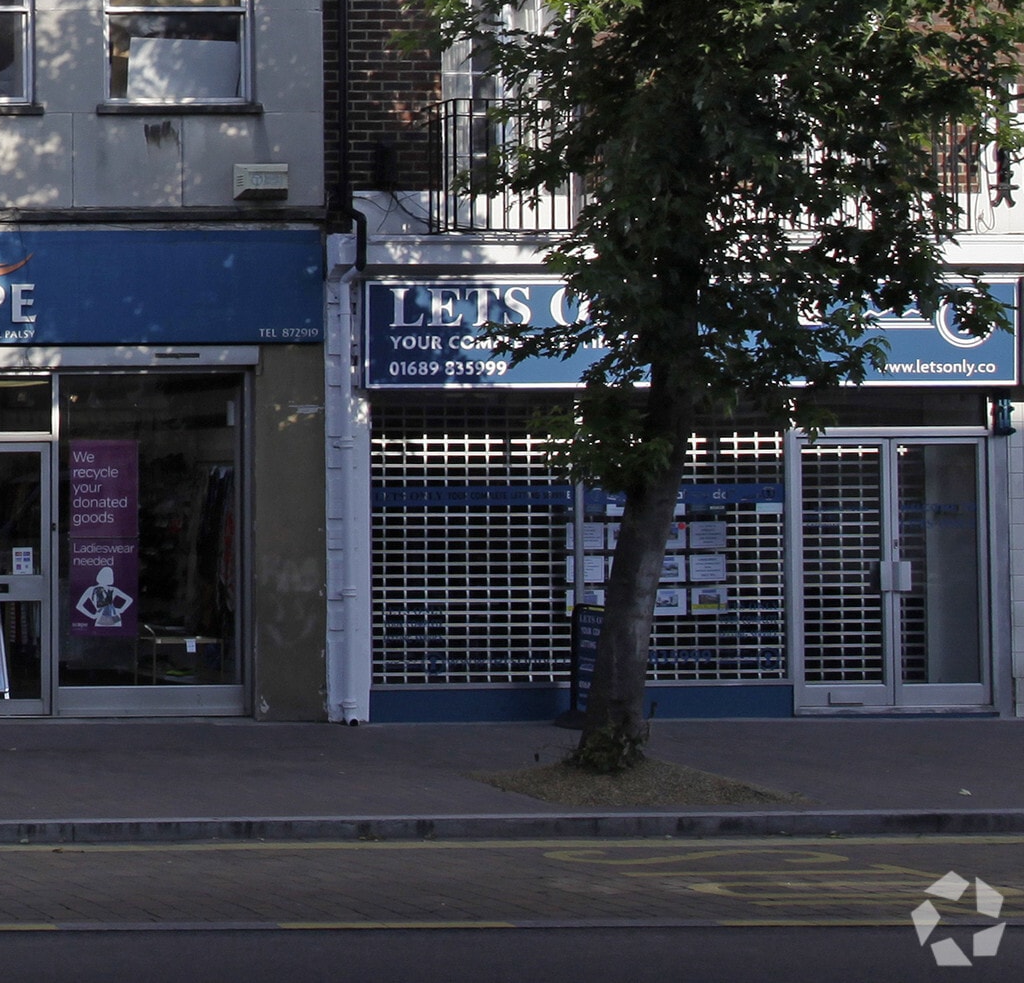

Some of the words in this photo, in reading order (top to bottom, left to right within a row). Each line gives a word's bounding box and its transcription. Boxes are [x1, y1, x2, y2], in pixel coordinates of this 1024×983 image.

[389, 286, 532, 328] LETS
[4, 330, 36, 339] PALSY
[259, 328, 277, 338] TEL
[282, 328, 319, 338] 872919
[389, 335, 442, 350] YOUR
[389, 361, 439, 376] 01689
[444, 361, 508, 376] 835999
[72, 451, 95, 463] We
[72, 466, 119, 481] recycle
[72, 483, 102, 494] your
[72, 496, 128, 508] donated
[72, 511, 114, 526] goods
[73, 543, 134, 554] Ladieswear
[73, 556, 114, 566] needed
